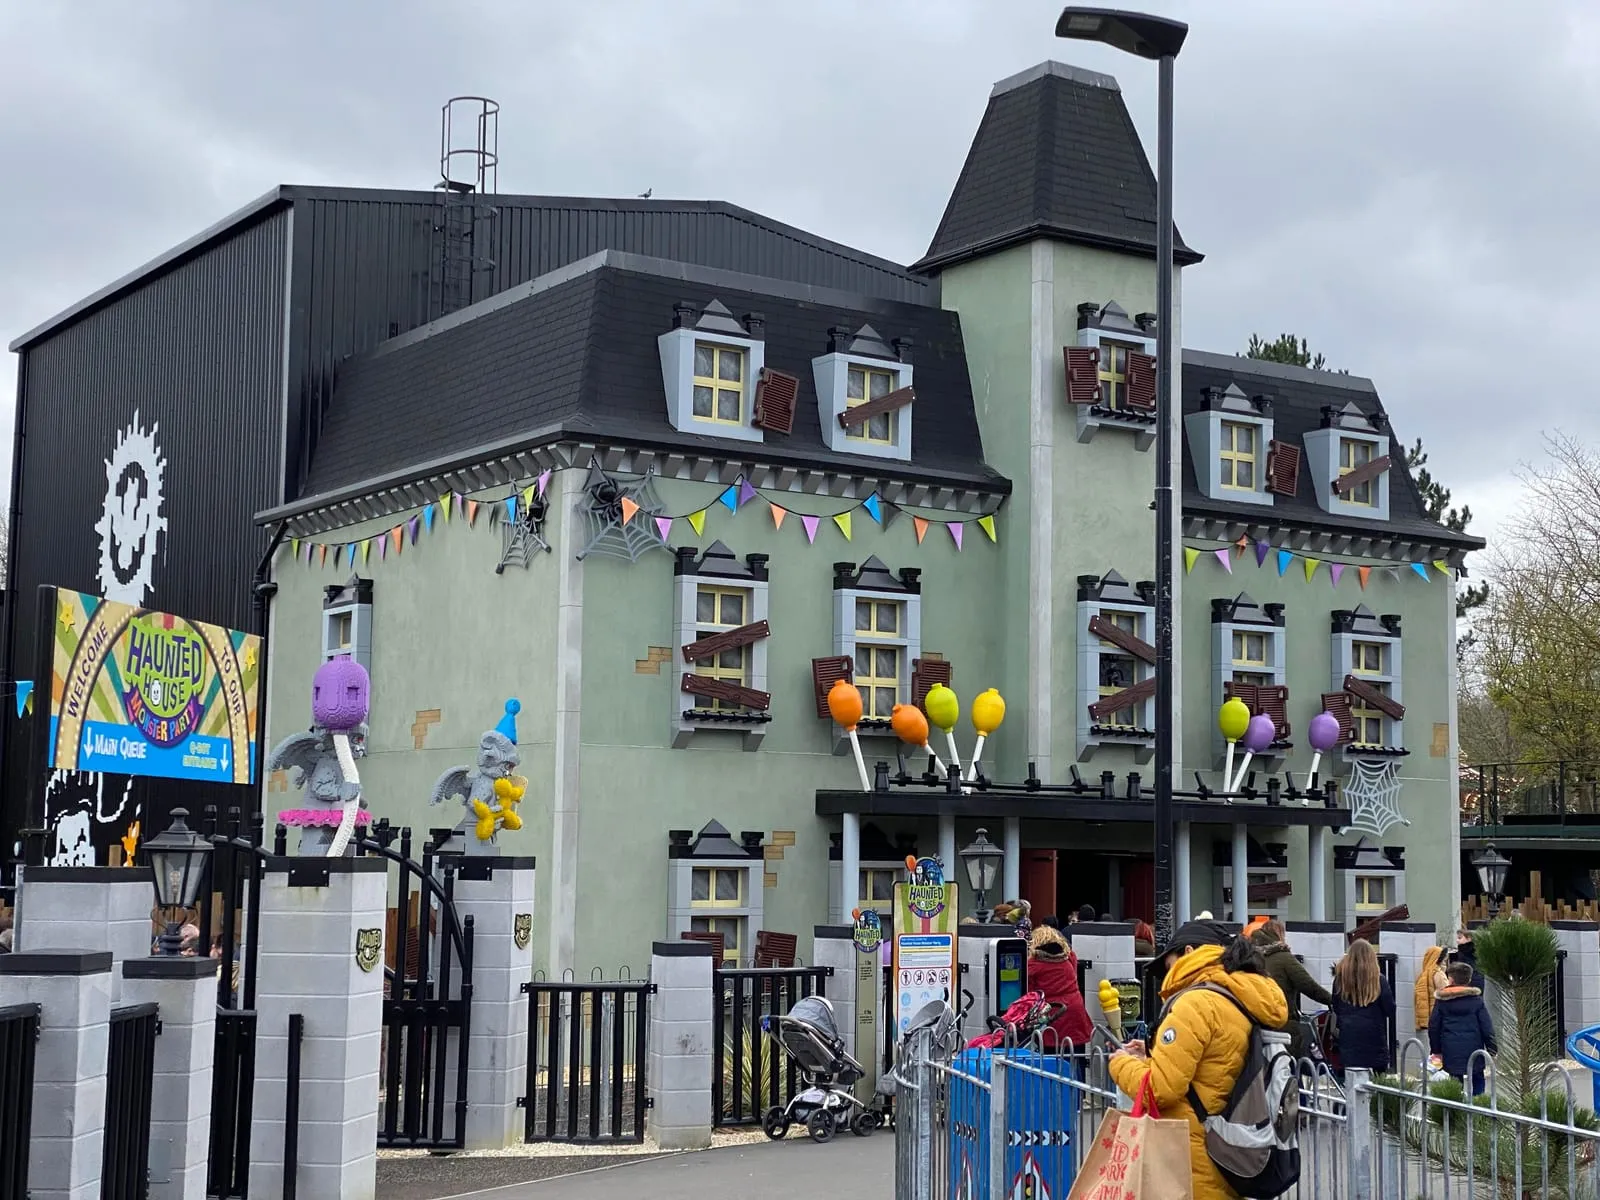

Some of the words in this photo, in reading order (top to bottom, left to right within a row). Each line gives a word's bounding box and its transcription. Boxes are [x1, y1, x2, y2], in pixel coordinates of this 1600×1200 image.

[67, 621, 109, 718] WELCOME
[126, 625, 203, 685] HAUNTED
[221, 647, 231, 673] TO
[143, 672, 185, 711] HOUSE
[130, 688, 168, 740] MONSTER
[168, 700, 196, 739] PARTY
[909, 886, 944, 901] HAUNTED
[855, 929, 880, 940] HAUNTED
